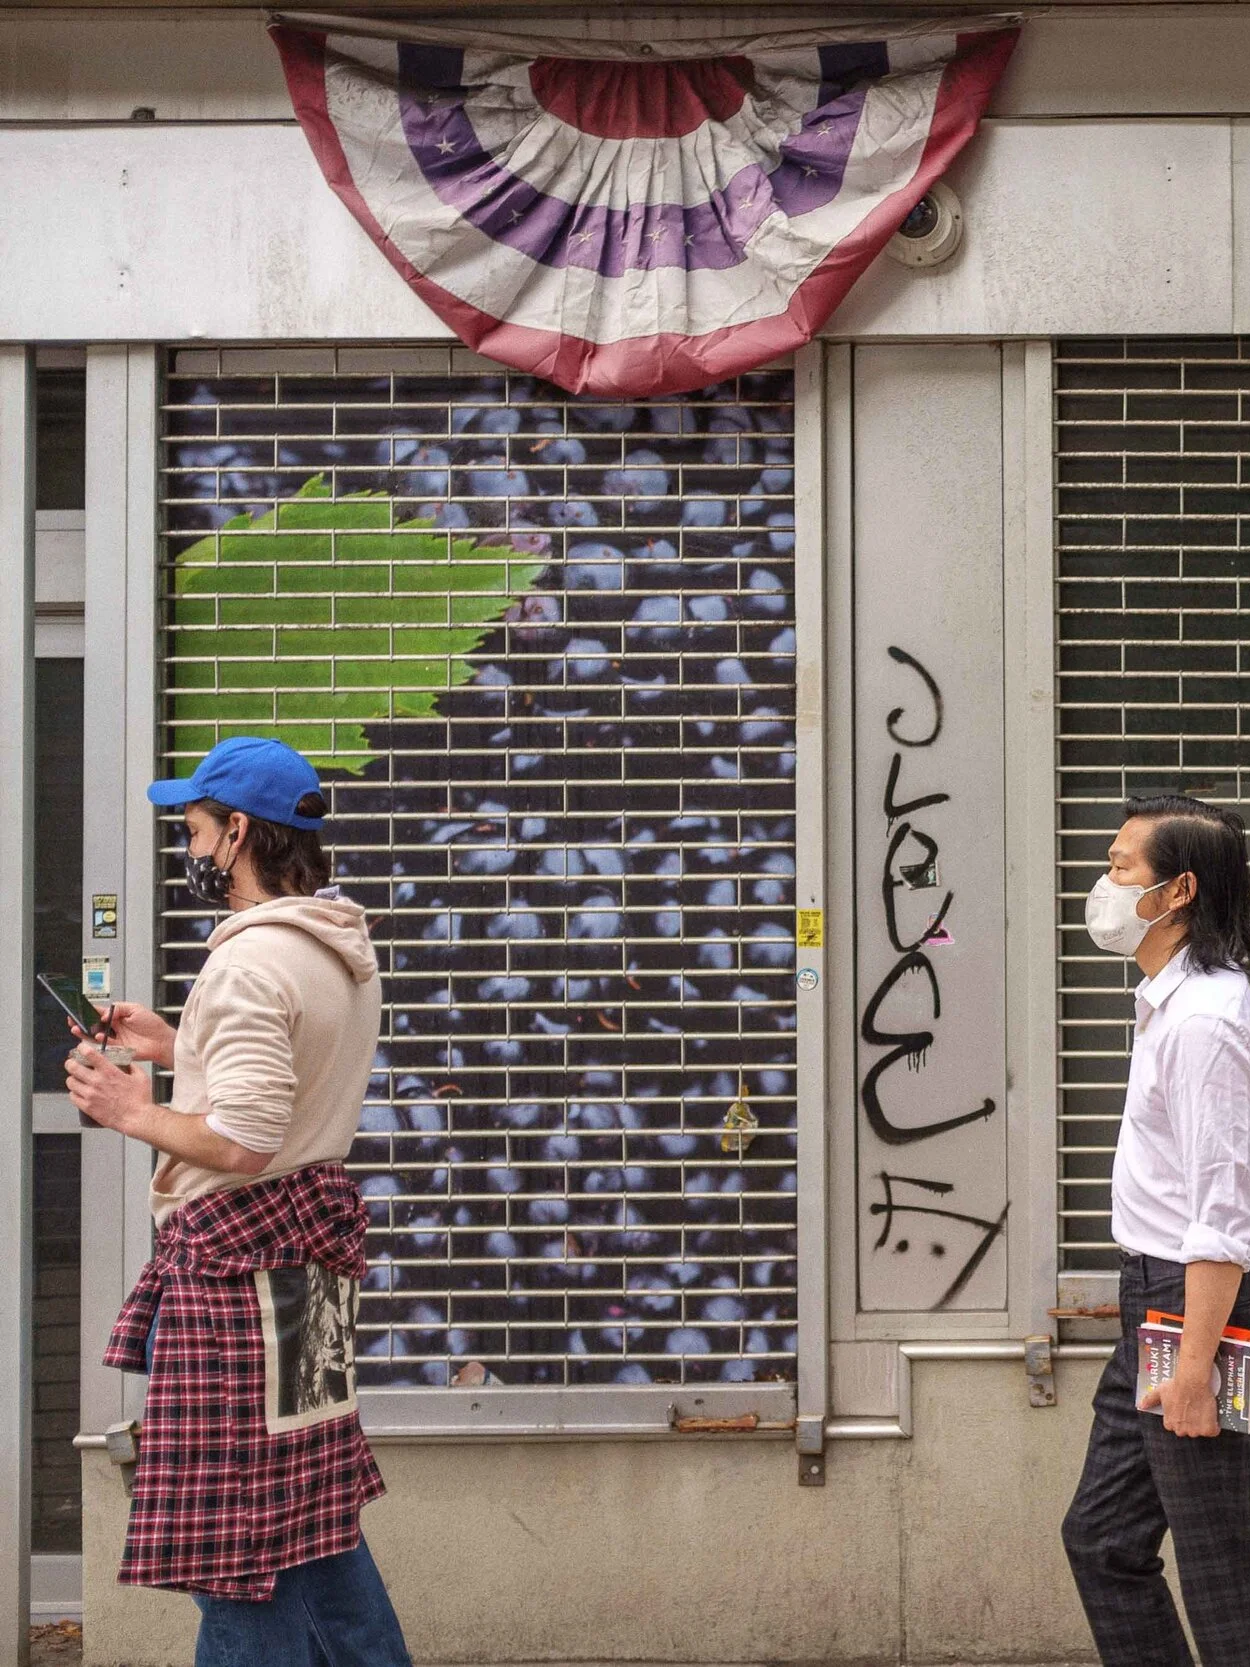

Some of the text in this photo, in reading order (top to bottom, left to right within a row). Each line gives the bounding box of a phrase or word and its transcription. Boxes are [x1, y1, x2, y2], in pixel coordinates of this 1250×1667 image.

[1150, 1347, 1159, 1389] HARUKI
[1161, 1338, 1172, 1381] RAKAMI
[1225, 1355, 1235, 1415] THE ELEPHANT
[1236, 1366, 1244, 1406] VANISHES
